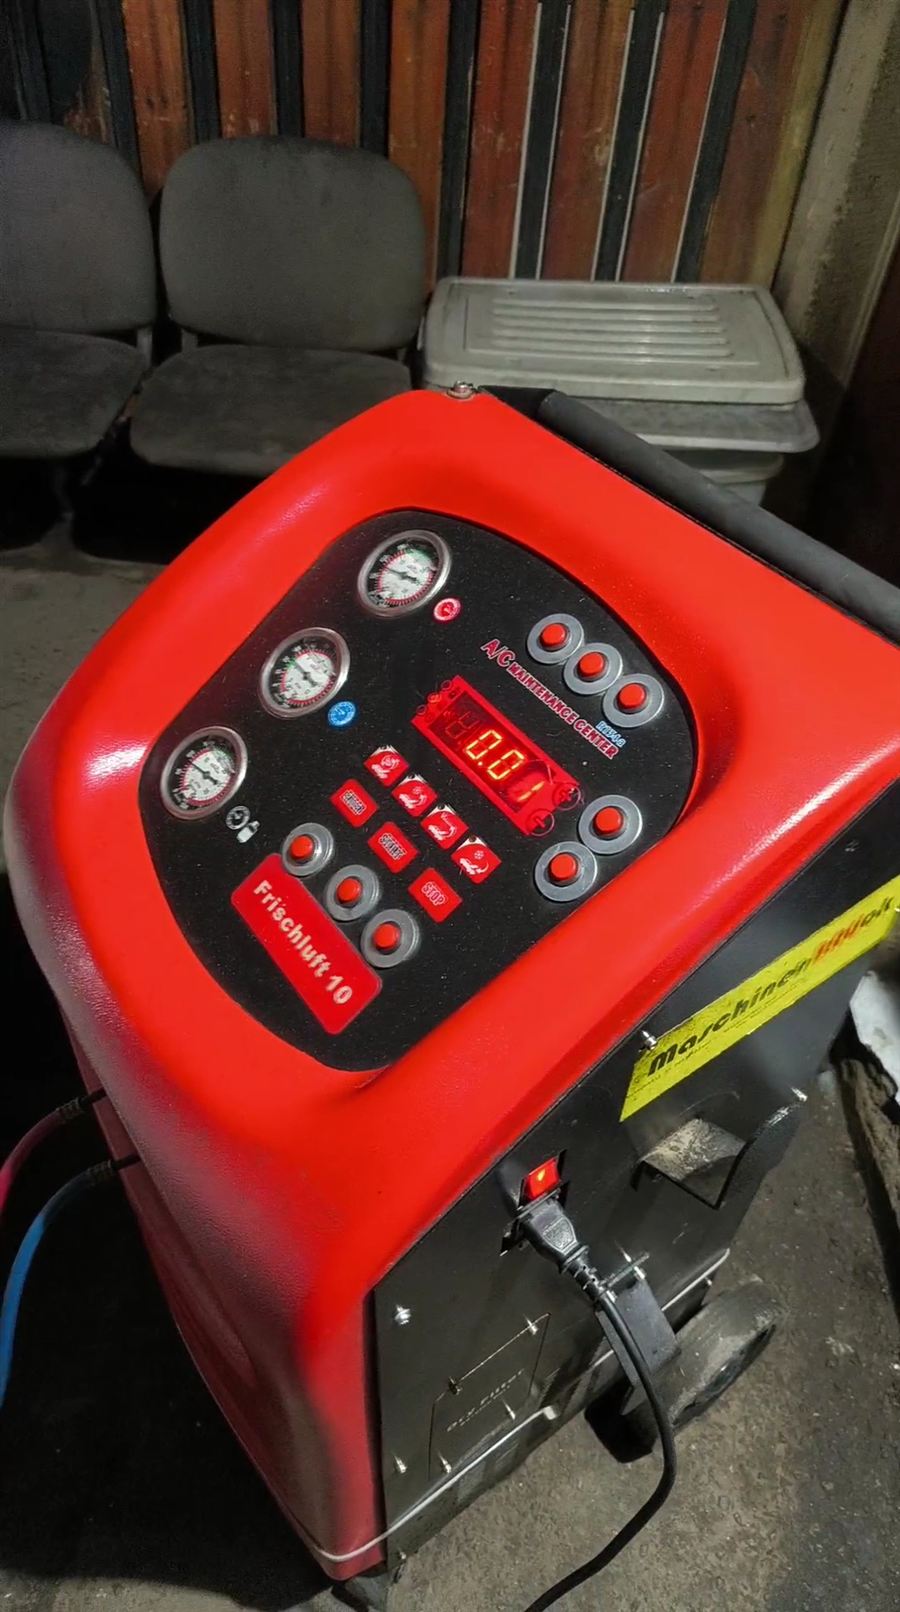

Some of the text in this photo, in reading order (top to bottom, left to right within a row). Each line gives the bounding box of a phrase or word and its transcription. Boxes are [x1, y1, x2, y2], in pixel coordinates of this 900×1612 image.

[481, 638, 620, 760] A/C MAINTENANCE CENTER
[253, 879, 354, 1005] Frischluft 10
[421, 881, 447, 906] STOP
